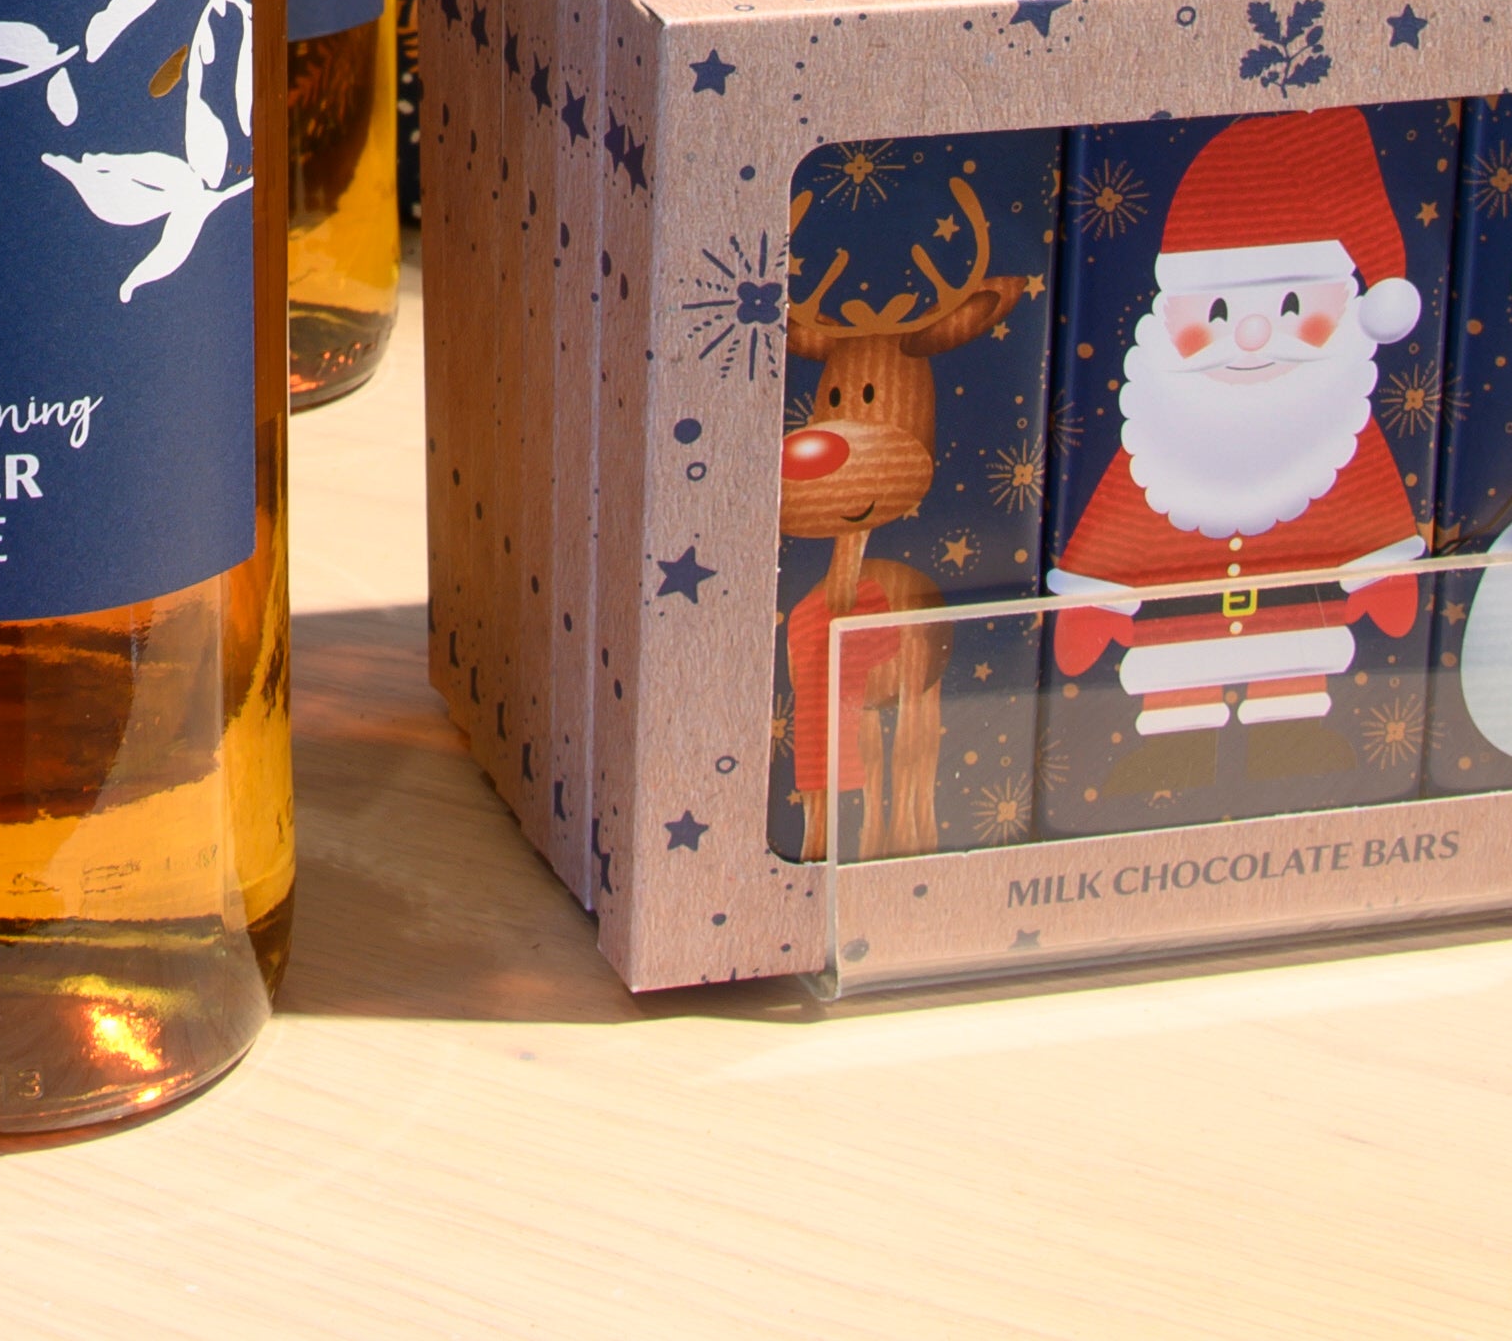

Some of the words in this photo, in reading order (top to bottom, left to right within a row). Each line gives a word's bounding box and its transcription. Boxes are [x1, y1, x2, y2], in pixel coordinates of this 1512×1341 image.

[1006, 869, 1103, 910] MILK
[1112, 843, 1354, 899] CHOCOLATE
[1361, 830, 1461, 870] BARS
